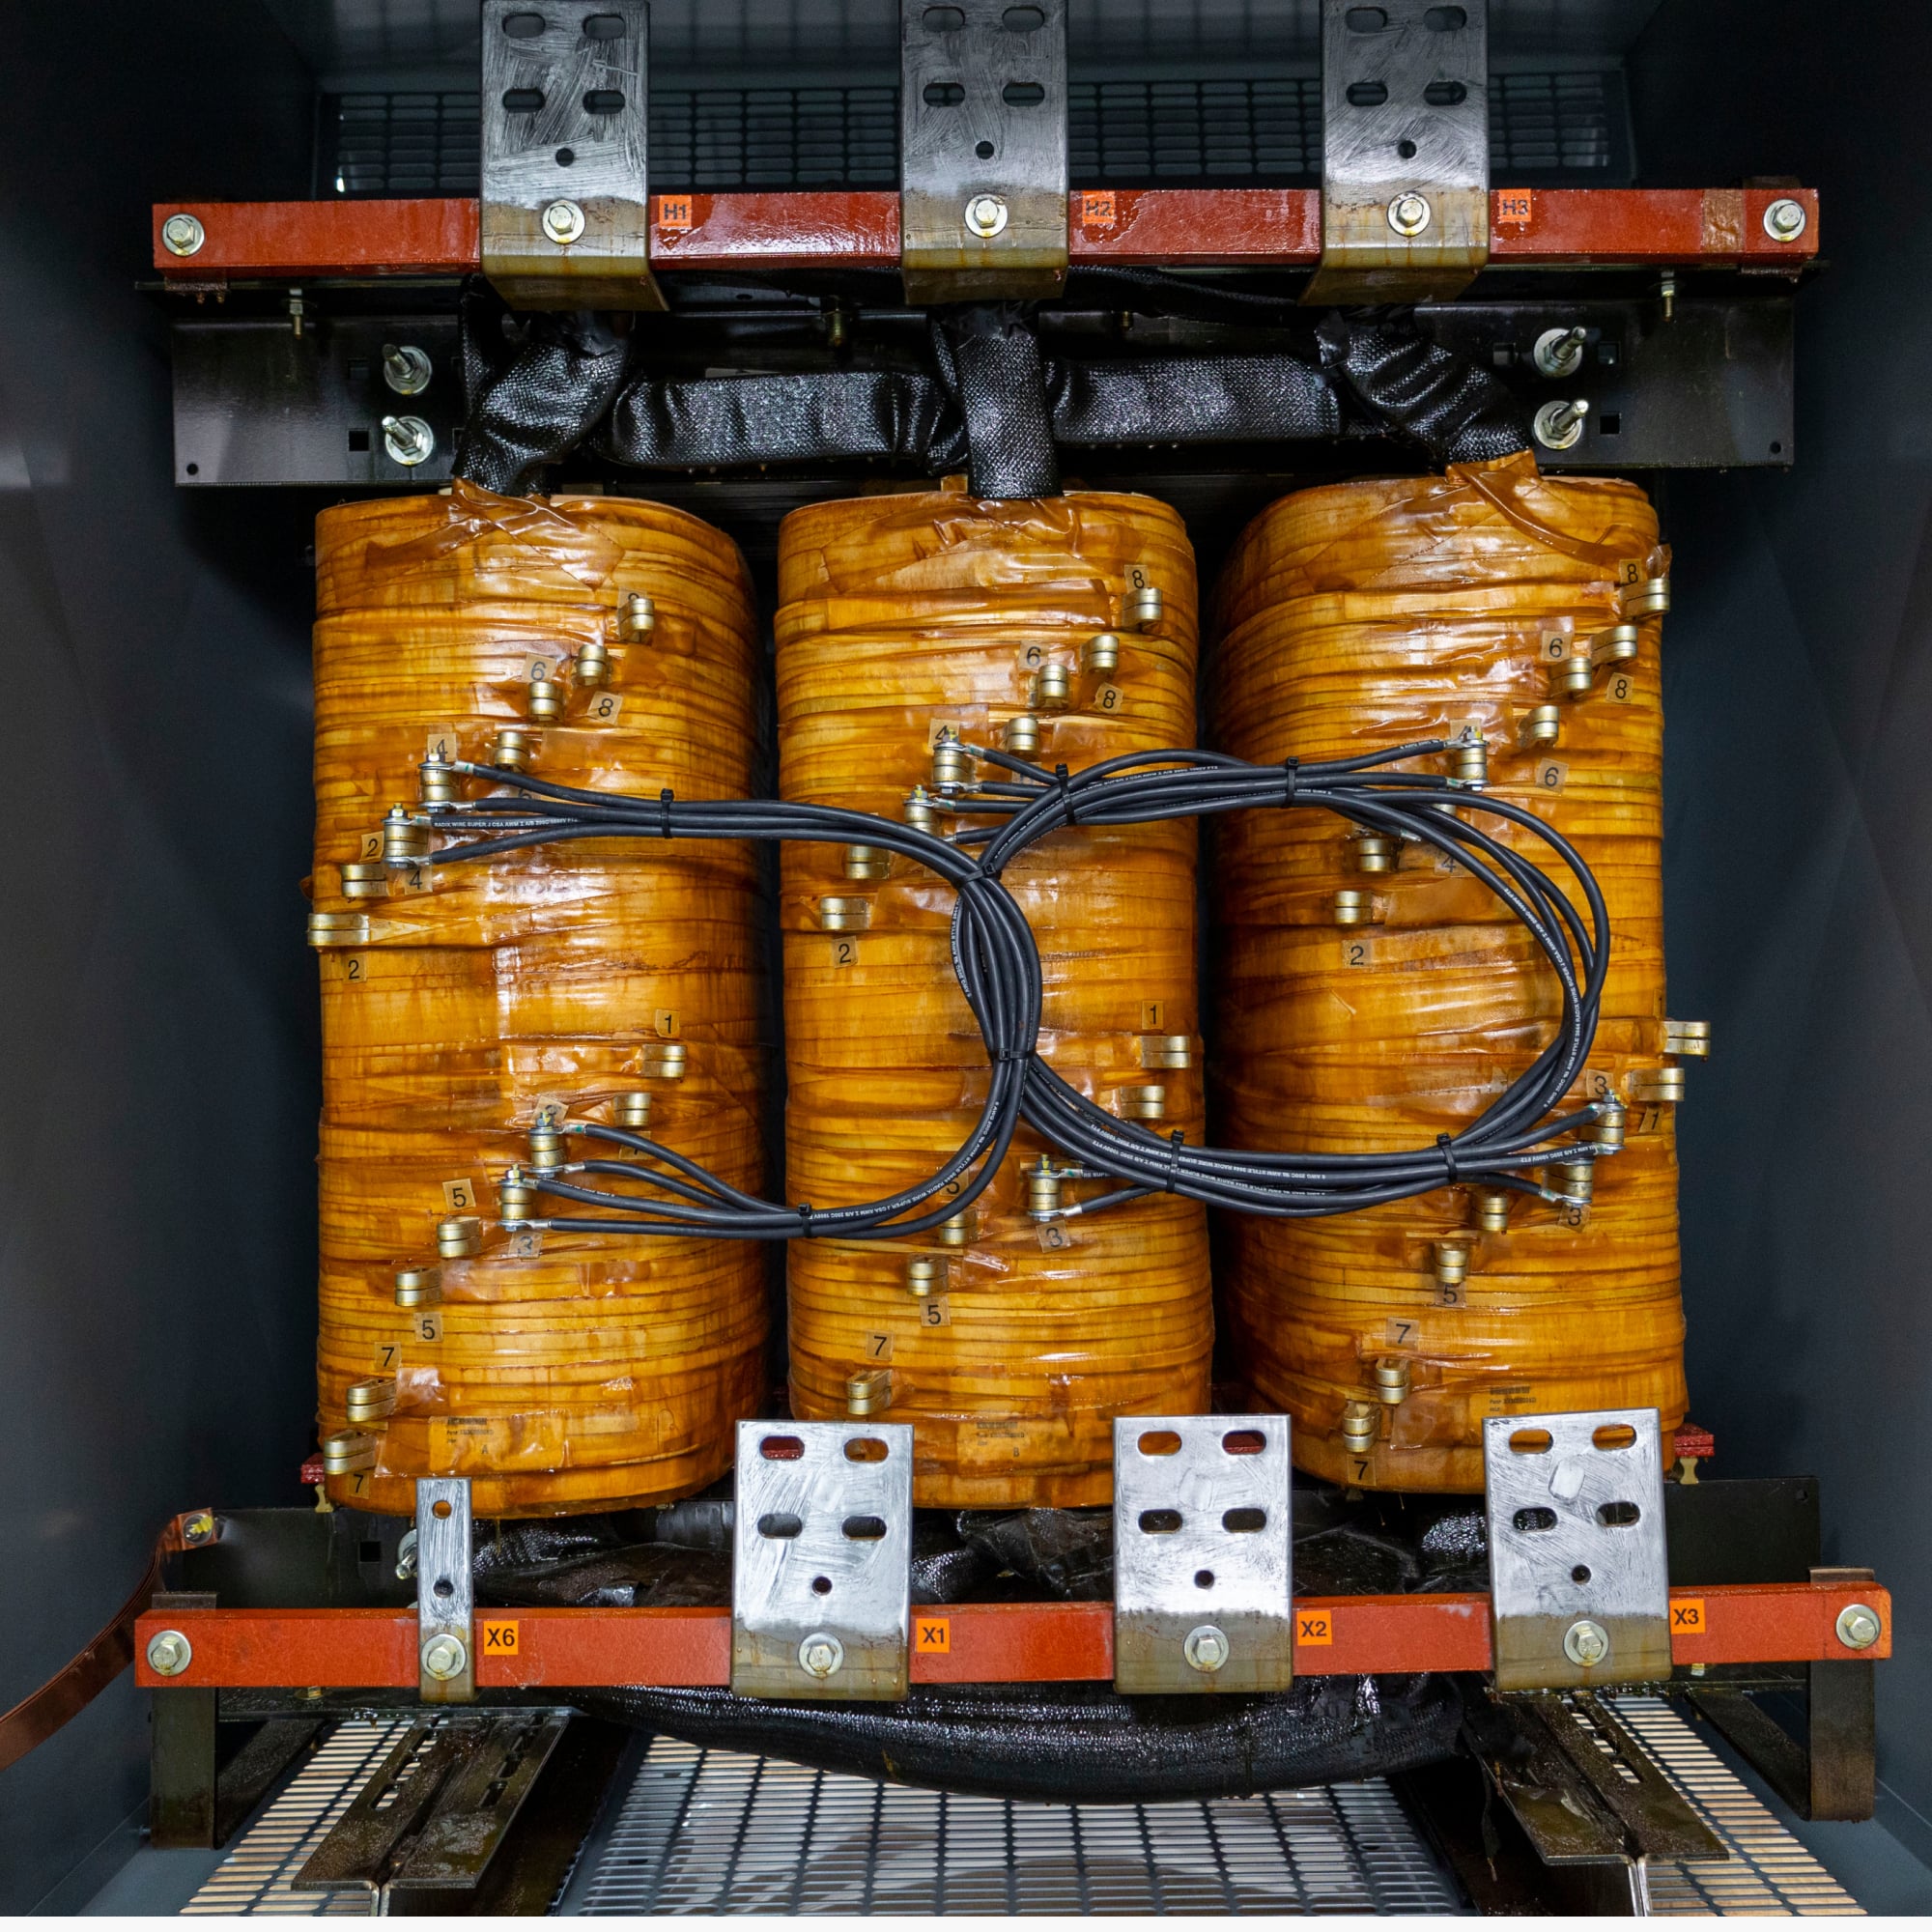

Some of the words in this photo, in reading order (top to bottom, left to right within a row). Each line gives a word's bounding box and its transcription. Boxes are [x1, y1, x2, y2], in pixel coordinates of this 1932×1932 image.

[664, 203, 687, 220] H1
[1085, 200, 1111, 215] H2
[1502, 199, 1527, 215] H3
[1131, 570, 1145, 589] 8
[1627, 563, 1638, 583] 8
[1027, 646, 1040, 667] 6
[1548, 638, 1563, 658] 6
[530, 661, 546, 680] 6
[1615, 679, 1628, 698] 8
[598, 697, 613, 717] 8
[1102, 690, 1116, 709] 8
[1545, 767, 1559, 786] 6
[367, 838, 378, 857] 2
[409, 869, 422, 890] 4
[838, 943, 851, 963] 2
[1544, 935, 1557, 952] AWM
[1350, 945, 1364, 965] 2
[1552, 949, 1564, 963] CSA
[348, 959, 359, 980] 2
[1561, 965, 1575, 987] SUPER
[1569, 986, 1578, 1003] WIRE
[665, 1014, 672, 1034] 1
[1150, 1005, 1156, 1024] 1
[1571, 1037, 1579, 1056] STYLE
[1594, 1075, 1607, 1094] 3
[1546, 1091, 1558, 1105] AWG
[988, 1105, 998, 1121] AWG
[954, 1155, 972, 1173] STYLE
[1212, 1161, 1233, 1170] RADIX
[452, 1187, 466, 1208] 5
[890, 1198, 911, 1209] SUPER
[873, 1205, 887, 1213] CSA
[1568, 1207, 1581, 1226] 3
[518, 1236, 533, 1255] 3
[1046, 1227, 1062, 1247] 3
[1443, 1284, 1457, 1304] 5
[927, 1304, 941, 1324] 5
[422, 1320, 435, 1340] 5
[1396, 1323, 1411, 1345] 7
[873, 1335, 887, 1355] 7
[381, 1347, 394, 1367] 7
[1354, 1461, 1368, 1480] 7
[353, 1473, 363, 1493] 7
[1673, 1608, 1699, 1625] X3
[487, 1628, 515, 1647] X6
[923, 1627, 944, 1643] X1
[1301, 1621, 1327, 1637] X2
